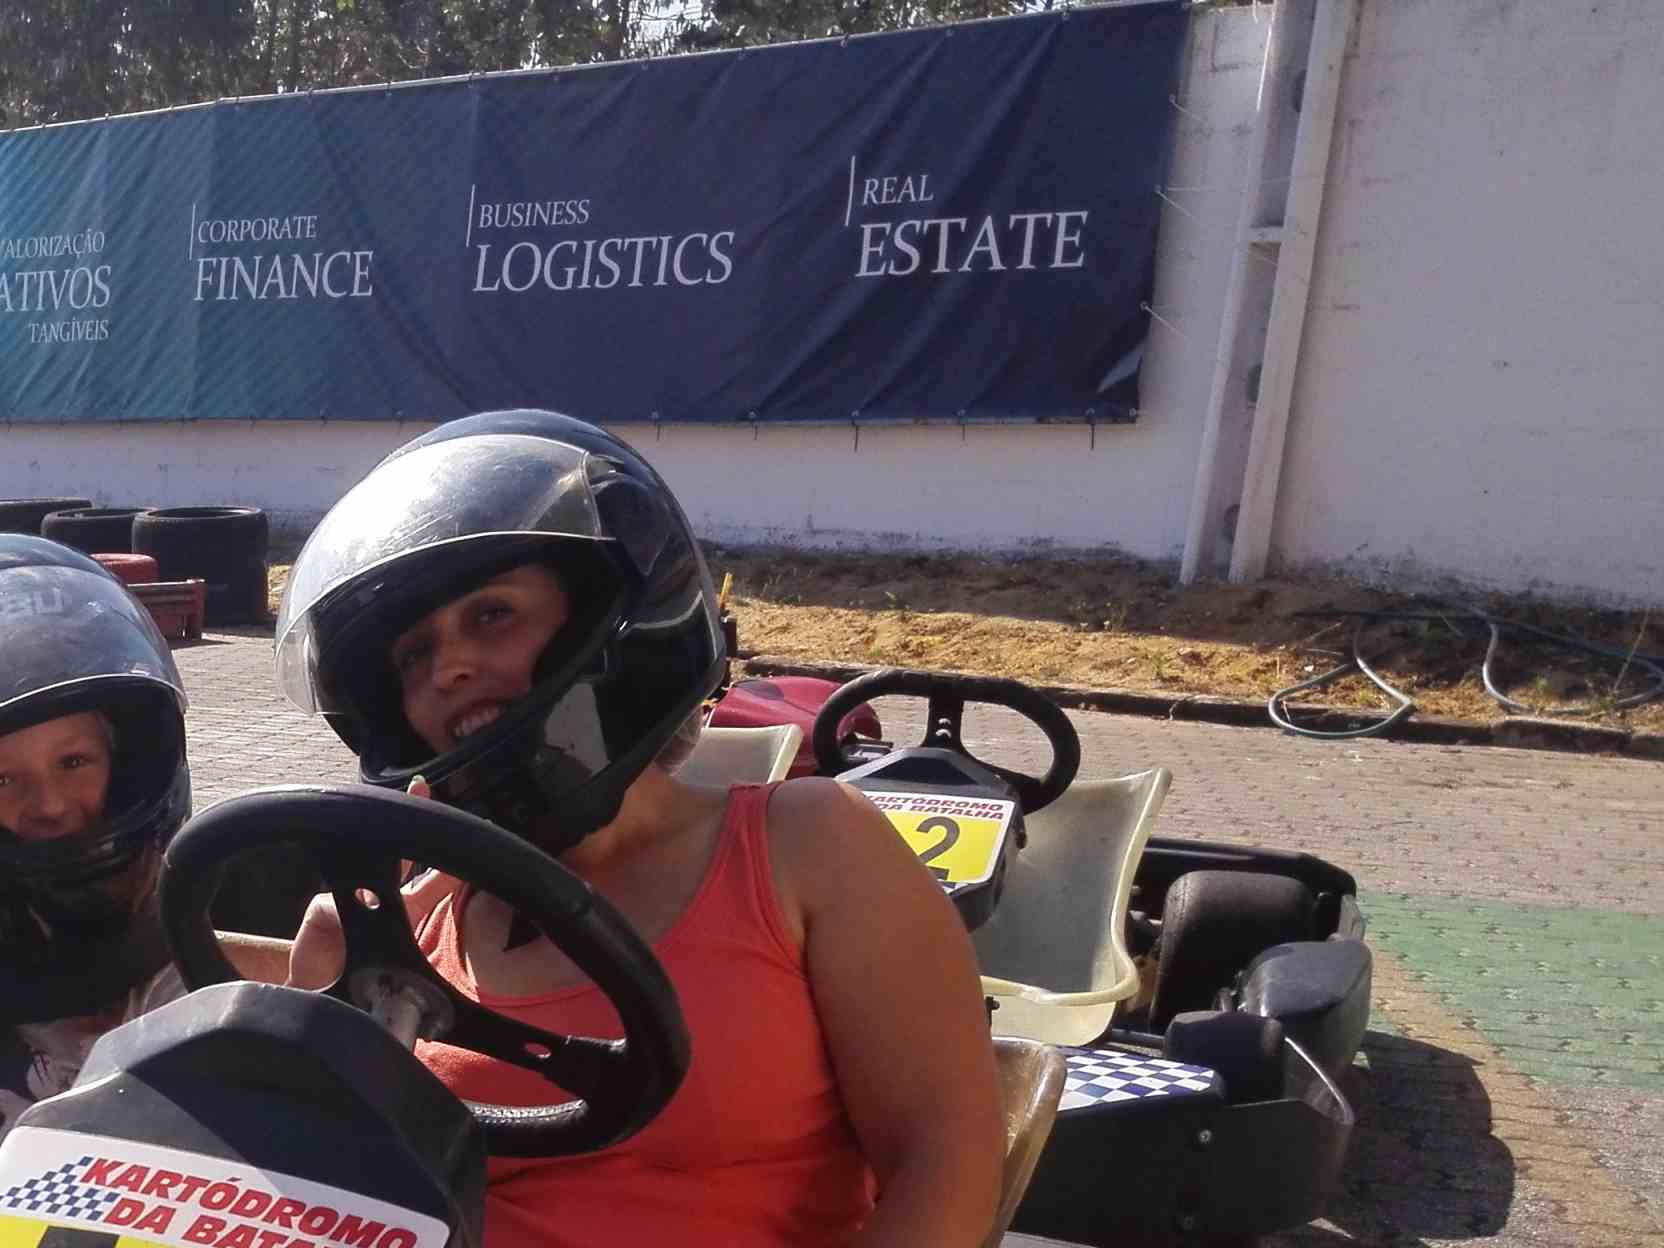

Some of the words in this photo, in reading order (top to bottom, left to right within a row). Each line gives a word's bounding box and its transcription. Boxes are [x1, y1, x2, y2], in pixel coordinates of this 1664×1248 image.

[861, 174, 935, 206] REAL
[198, 215, 317, 243] CORPORATE
[478, 199, 590, 229] BUSINESS
[855, 211, 1089, 278] ESTATE
[193, 250, 374, 301] FINANCE
[473, 232, 735, 293] LOGISTICS
[29, 317, 109, 344] TANGÍVEIS
[909, 804, 1005, 820] BATALHA
[103, 1198, 177, 1234] DA
